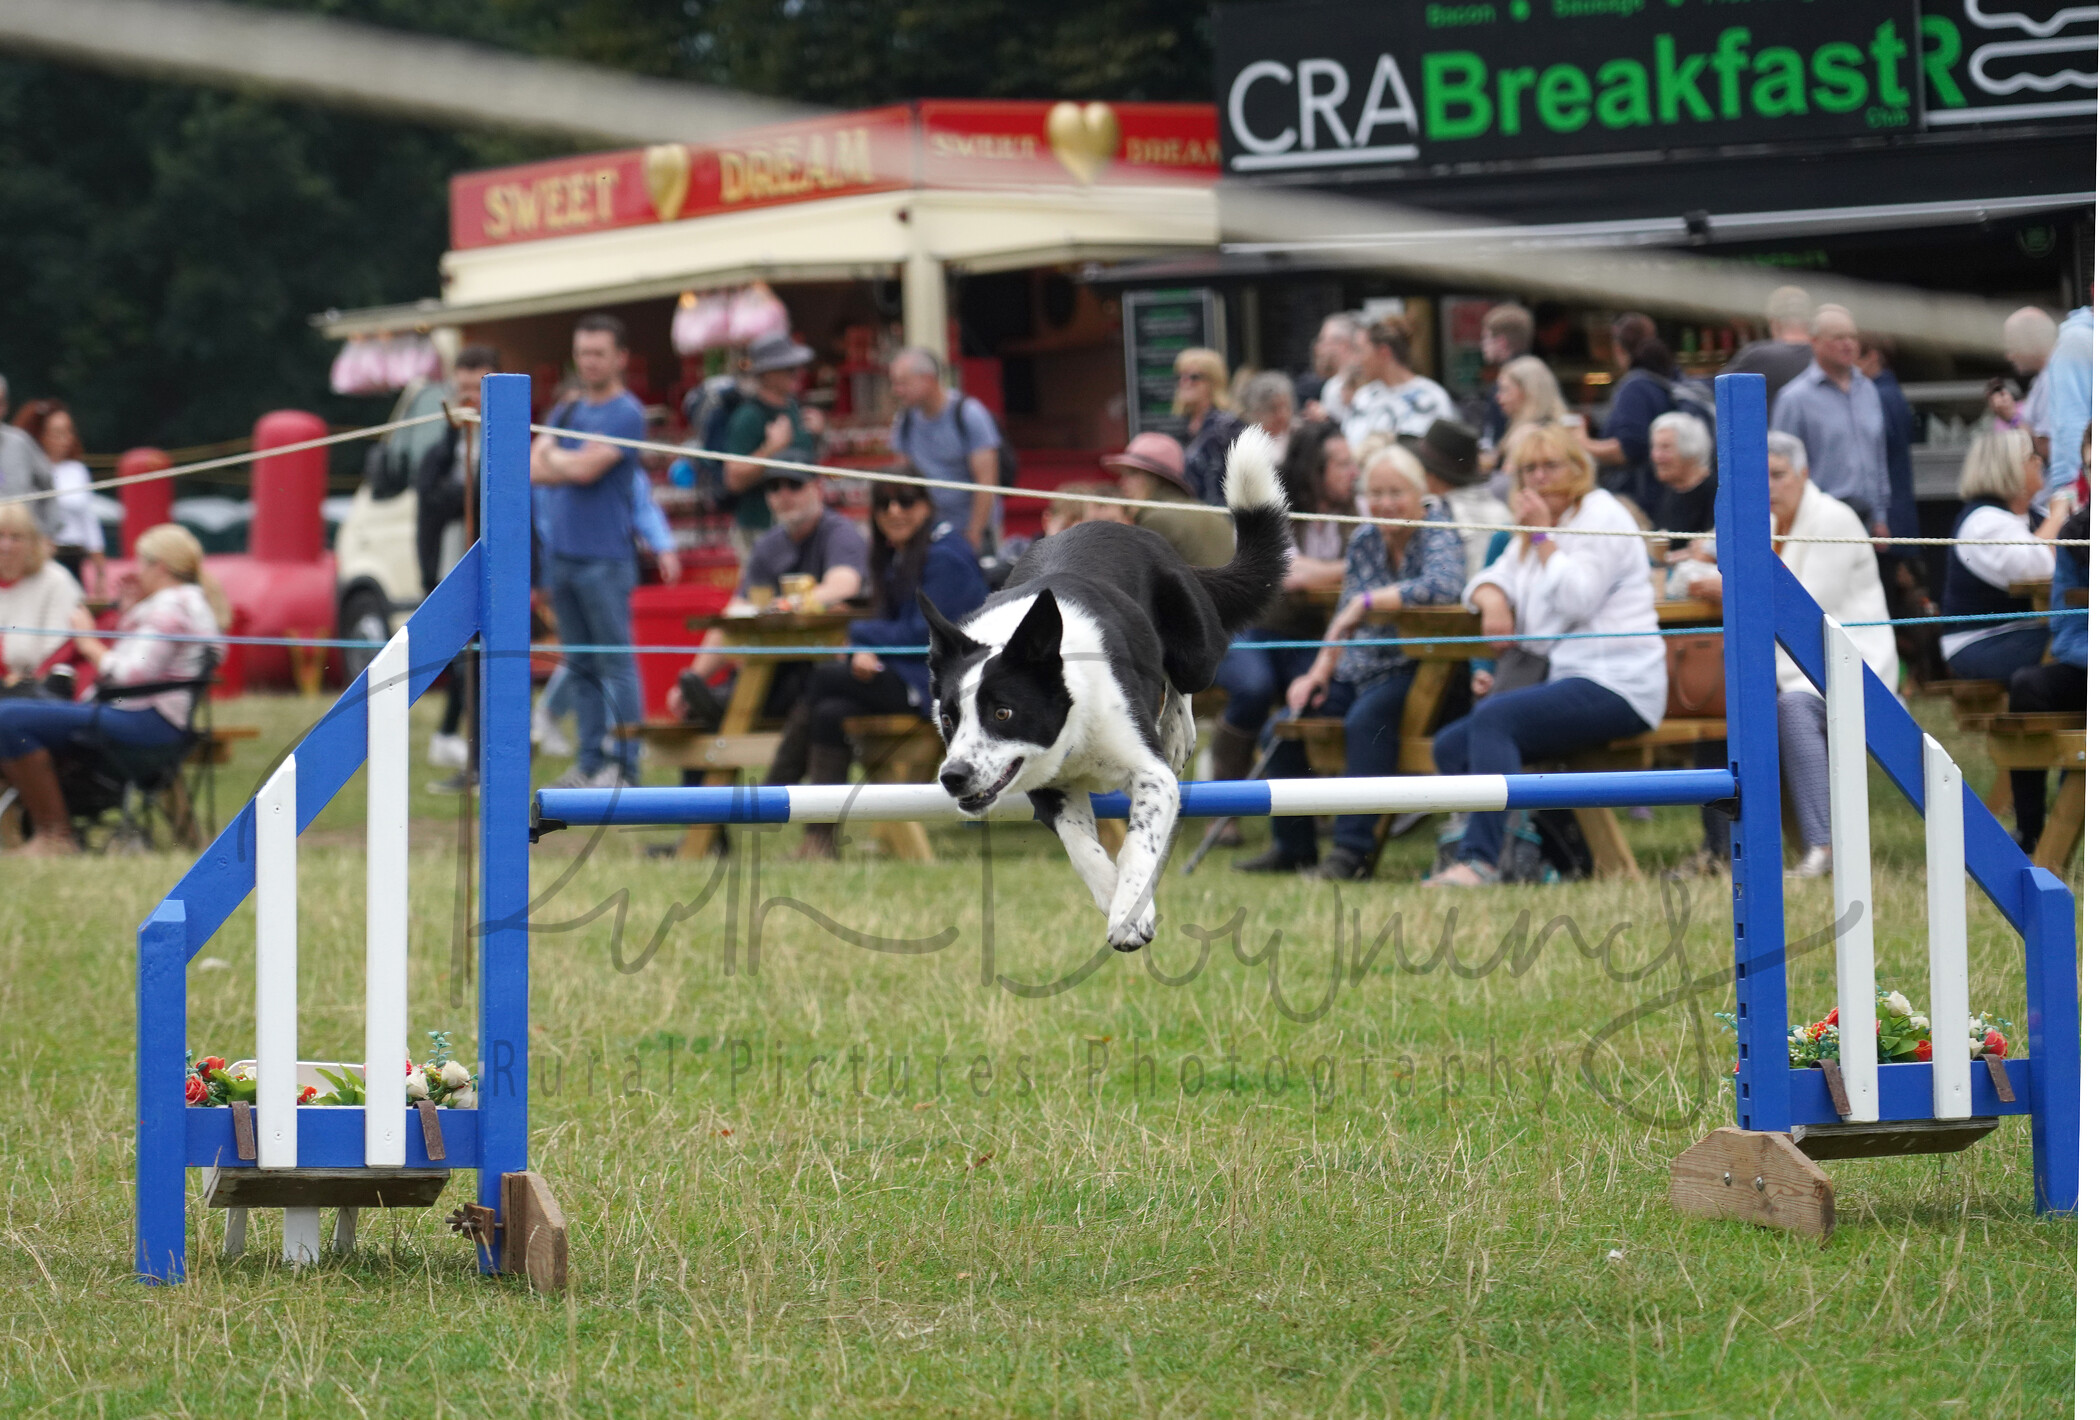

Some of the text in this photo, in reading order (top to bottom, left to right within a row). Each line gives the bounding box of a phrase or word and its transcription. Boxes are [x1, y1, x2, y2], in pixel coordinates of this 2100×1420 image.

[1422, 18, 1912, 141] Breakfast
[484, 128, 873, 240] SWEET DREAM
[932, 131, 1038, 160] SWEET
